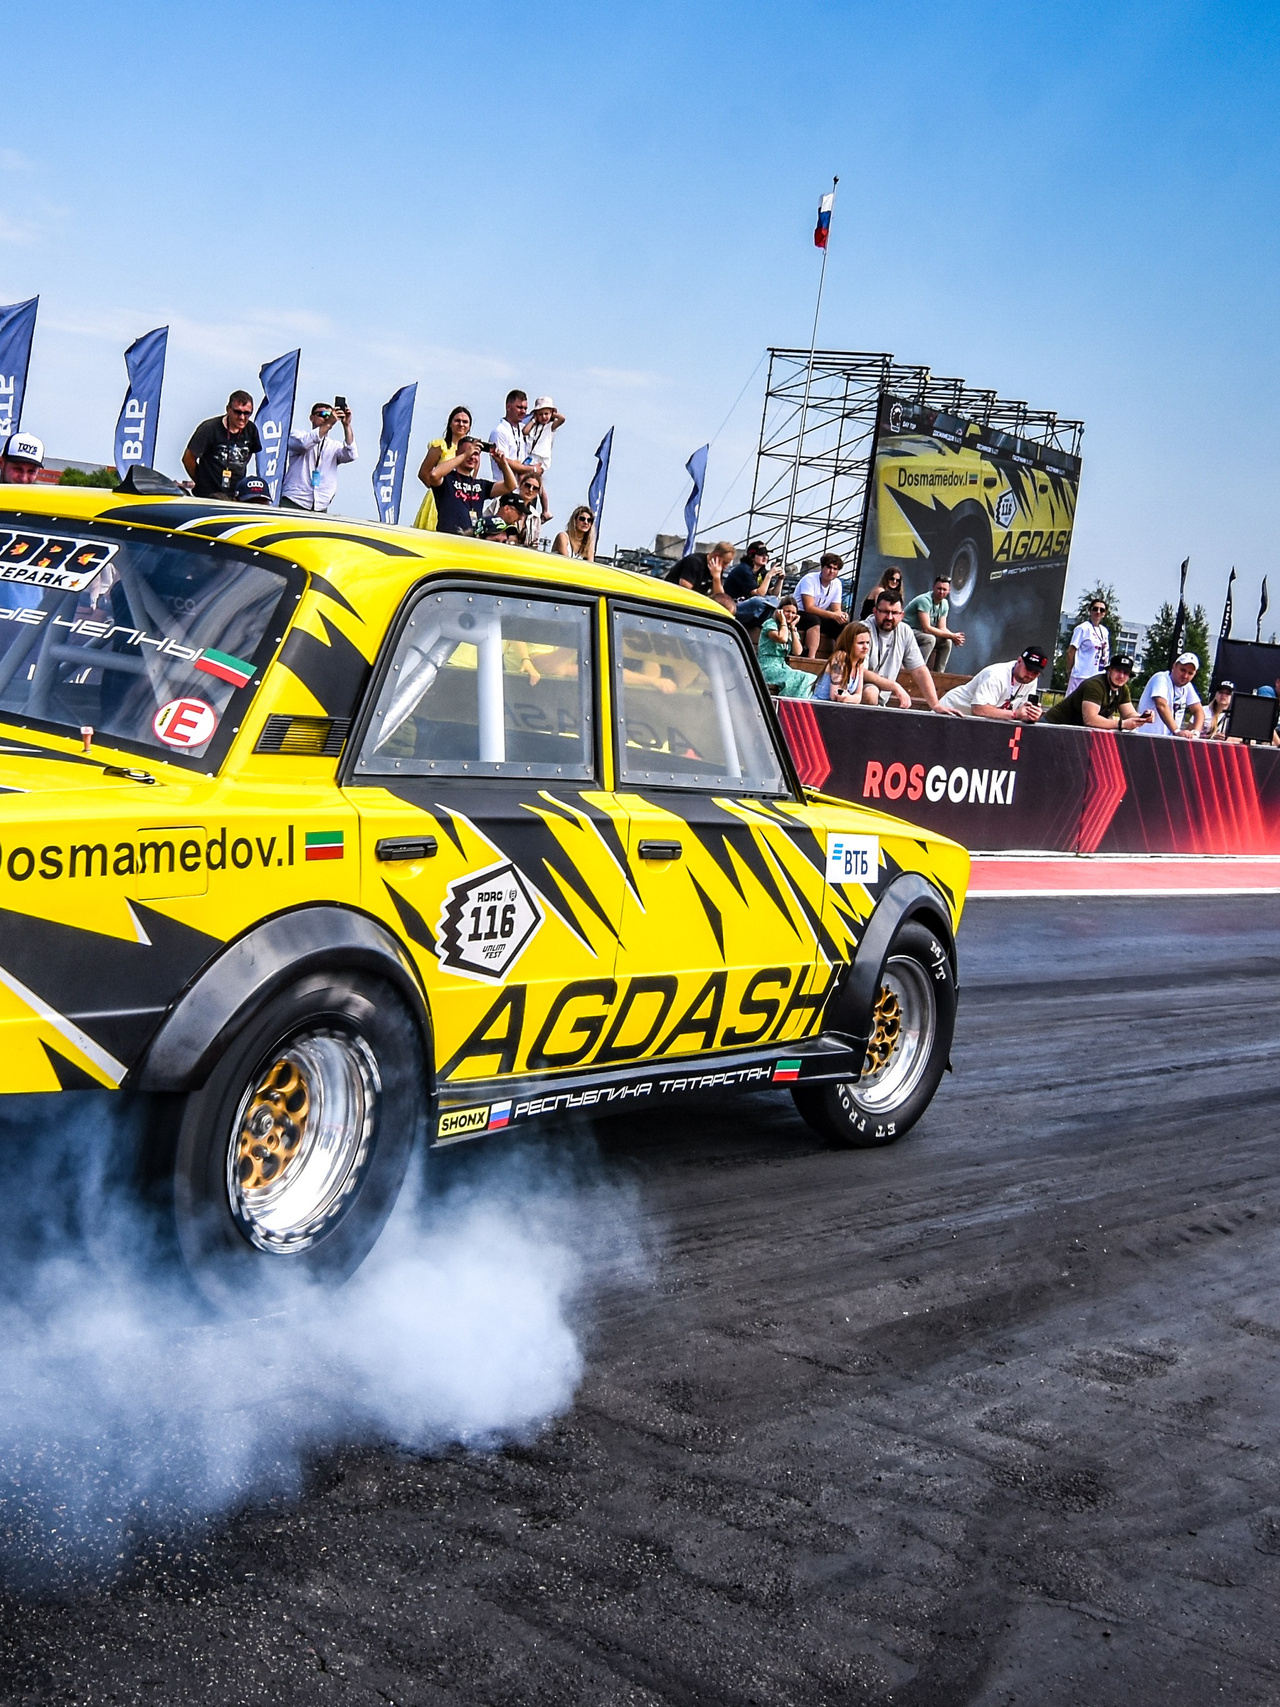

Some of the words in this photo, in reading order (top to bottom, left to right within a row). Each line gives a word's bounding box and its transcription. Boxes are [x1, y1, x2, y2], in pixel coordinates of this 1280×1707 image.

[52, 615, 205, 662] ЧЕЛНЫ
[163, 702, 206, 743] E
[862, 761, 1017, 805] ROSGONKI
[844, 850, 868, 875] ВТБ
[477, 891, 503, 903] RDRC
[468, 904, 516, 942] 116
[484, 951, 503, 959] FEST
[435, 964, 838, 1076] AGDASH
[514, 1083, 652, 1119] РЕСПУБЛИКА
[660, 1066, 773, 1093] ТАТАРСТАН
[836, 1084, 866, 1133] FRON
[441, 1111, 487, 1132] SHONX
